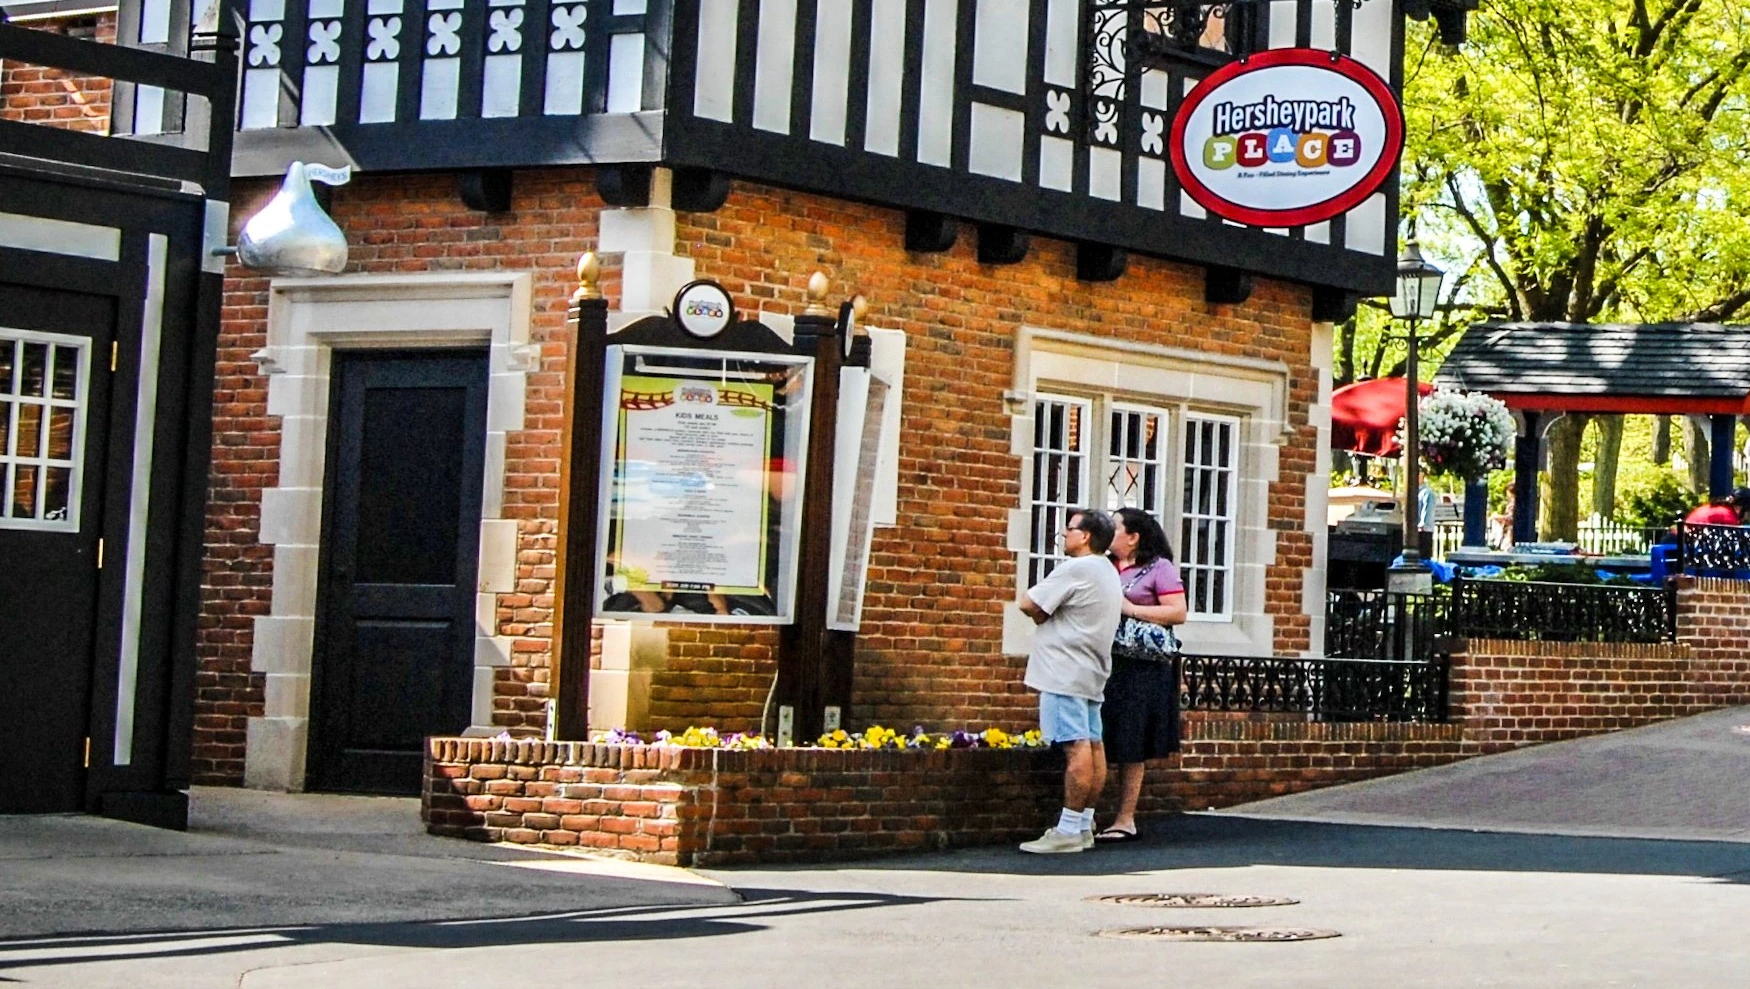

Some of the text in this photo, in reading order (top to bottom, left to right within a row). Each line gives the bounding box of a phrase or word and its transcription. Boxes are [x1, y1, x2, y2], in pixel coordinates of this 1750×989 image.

[1214, 95, 1355, 135] Hersheypark
[1212, 134, 1355, 162] PLACE
[675, 412, 719, 421] KIDS MEALS
